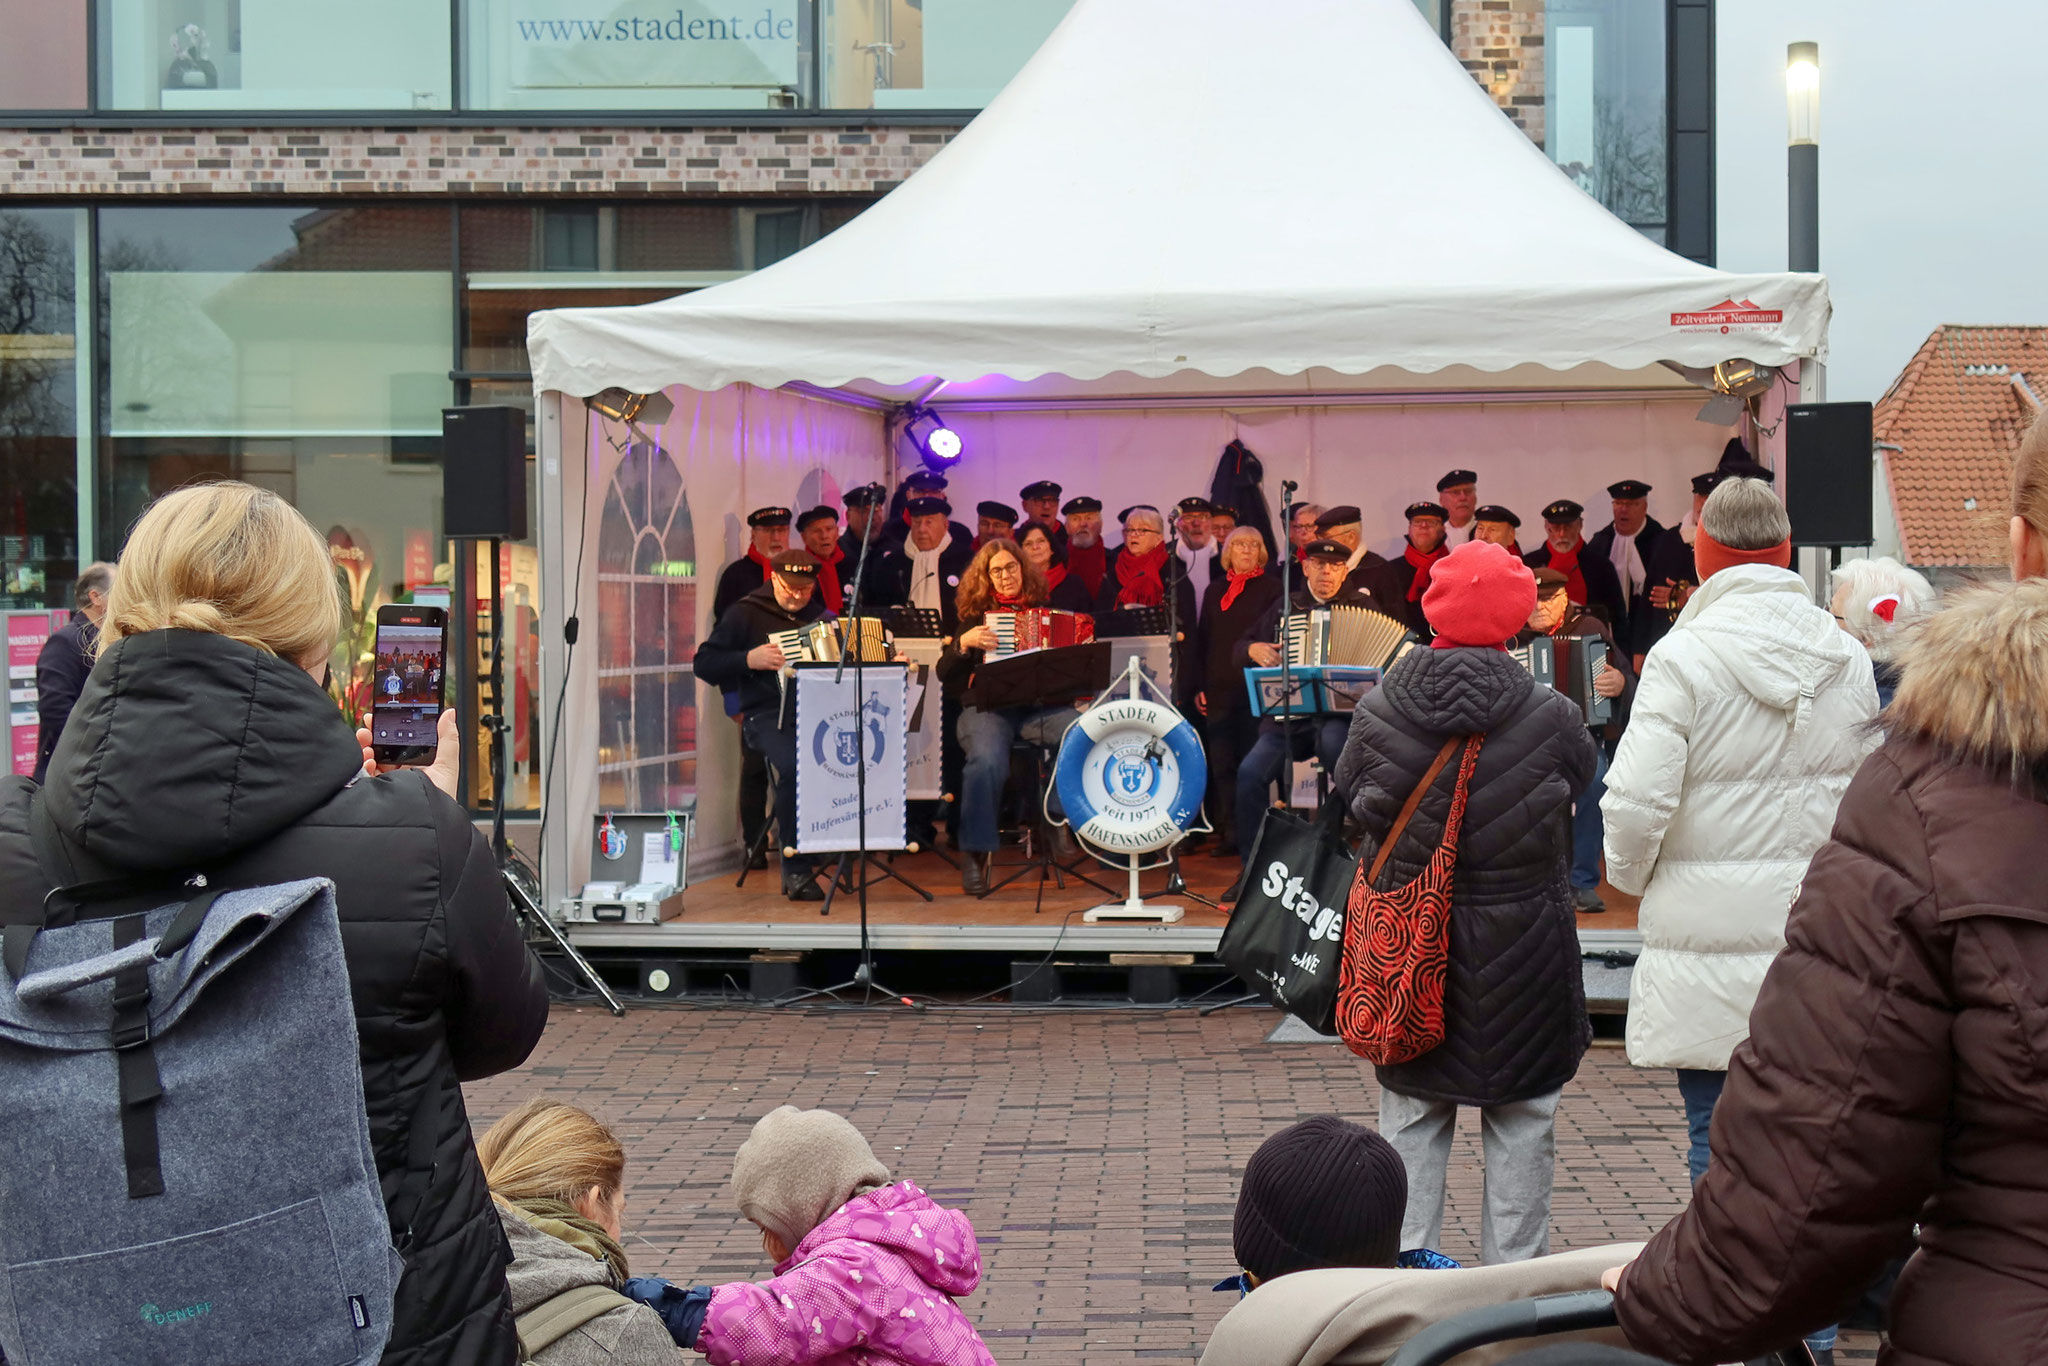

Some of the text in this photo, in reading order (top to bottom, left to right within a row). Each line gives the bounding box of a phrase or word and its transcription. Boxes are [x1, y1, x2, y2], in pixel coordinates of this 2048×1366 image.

[516, 9, 793, 41] www.stadent.de
[1675, 312, 1779, 325] Zeltverleih Neumann
[829, 710, 860, 721] STADE
[1098, 706, 1157, 726] STADER
[831, 793, 861, 809] Stade
[811, 805, 873, 832] Hafensäner
[1102, 805, 1157, 822] seit 1977
[1087, 808, 1190, 847] HAFENSÄNGER e.V.
[1262, 861, 1344, 942] Stage
